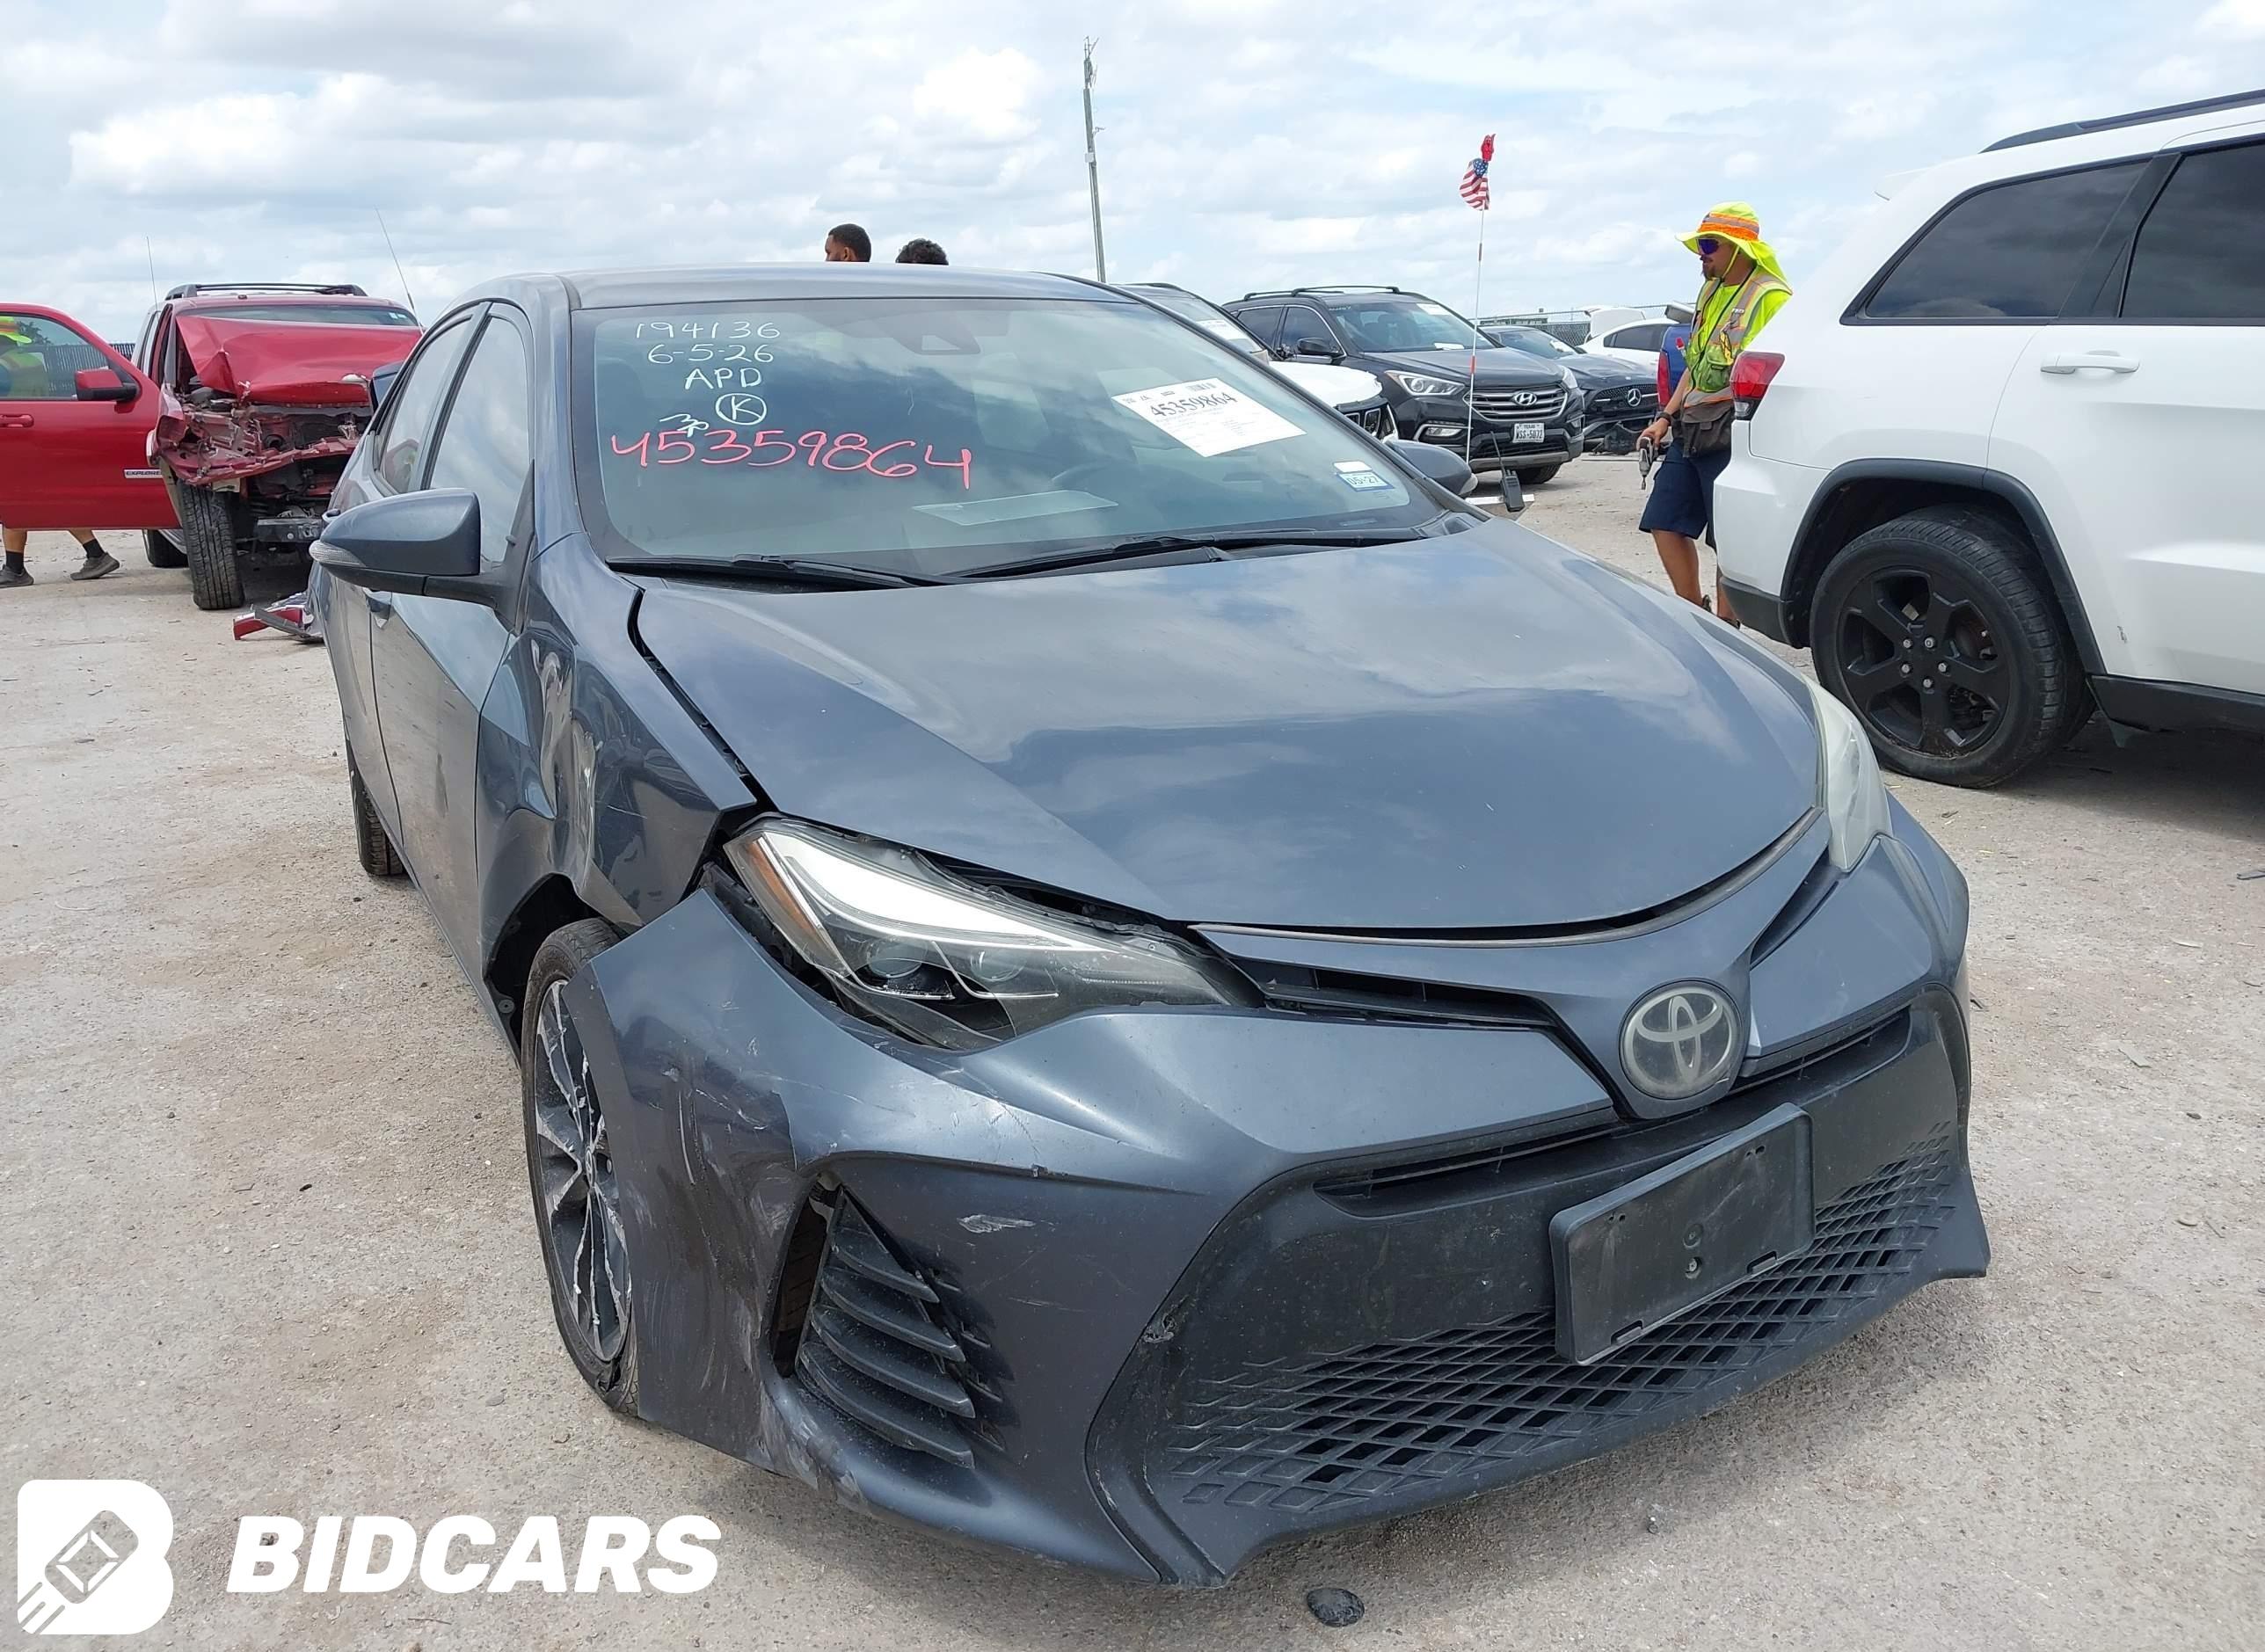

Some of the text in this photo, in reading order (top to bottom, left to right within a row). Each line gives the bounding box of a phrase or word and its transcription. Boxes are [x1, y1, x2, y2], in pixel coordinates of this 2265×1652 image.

[635, 320, 781, 339] 194136
[647, 344, 775, 365] 6-5-26
[683, 368, 763, 390] APD
[1150, 392, 1238, 416] 45359864
[611, 429, 972, 490] 45359864
